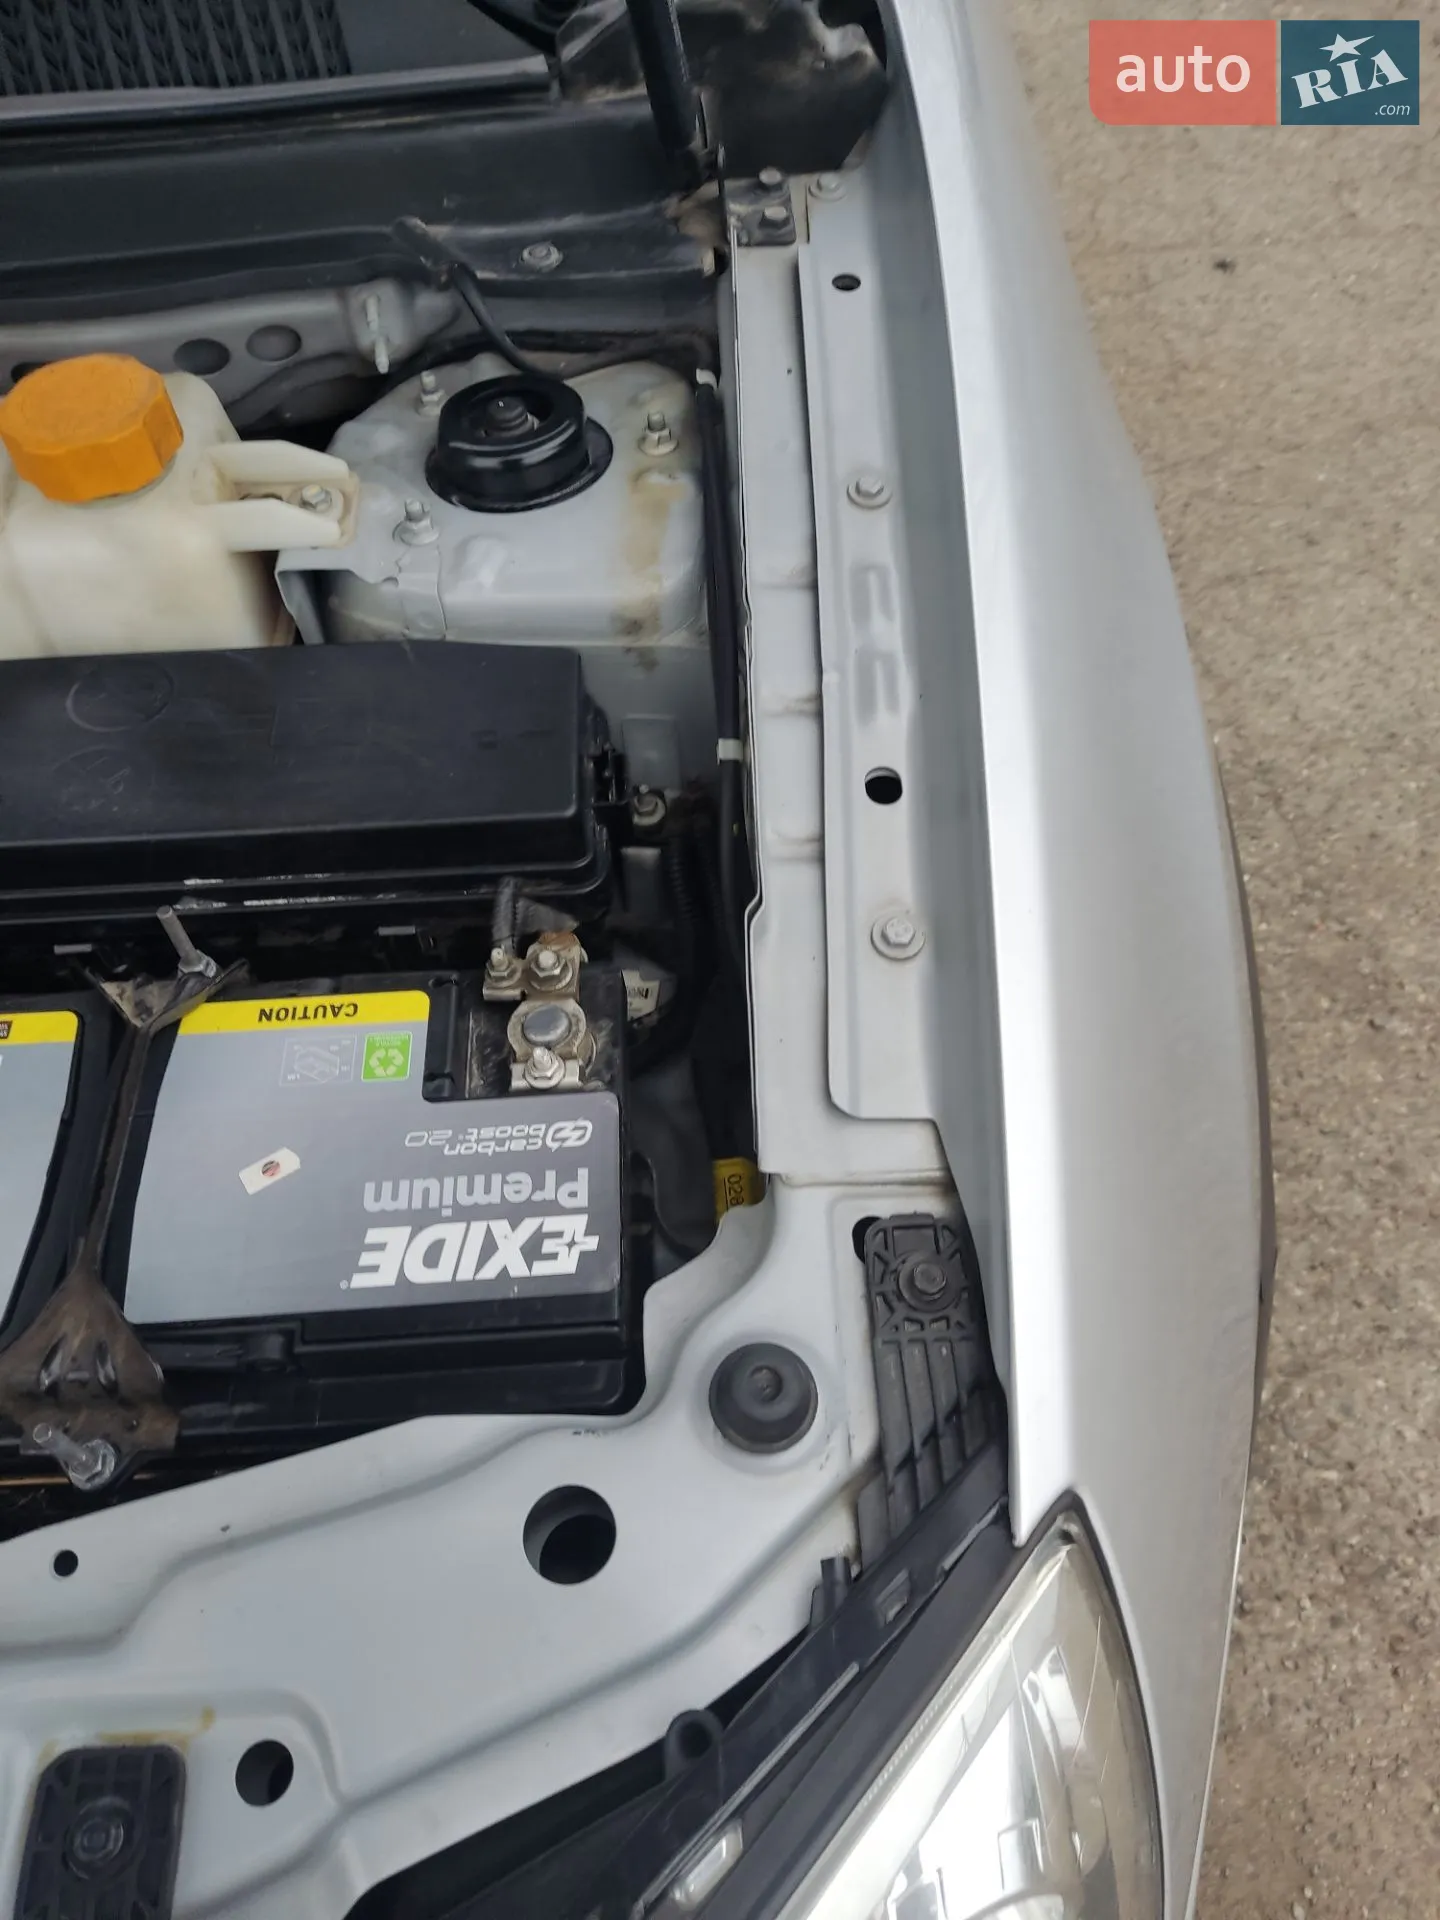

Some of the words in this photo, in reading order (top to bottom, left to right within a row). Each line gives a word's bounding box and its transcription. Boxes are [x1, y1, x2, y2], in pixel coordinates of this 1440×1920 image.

[257, 1003, 358, 1023] CAUTION
[404, 1129, 453, 1147] 2.0
[443, 1137, 542, 1157] carbon
[363, 1167, 588, 1217] Premium
[350, 1213, 599, 1289] EXIDE
